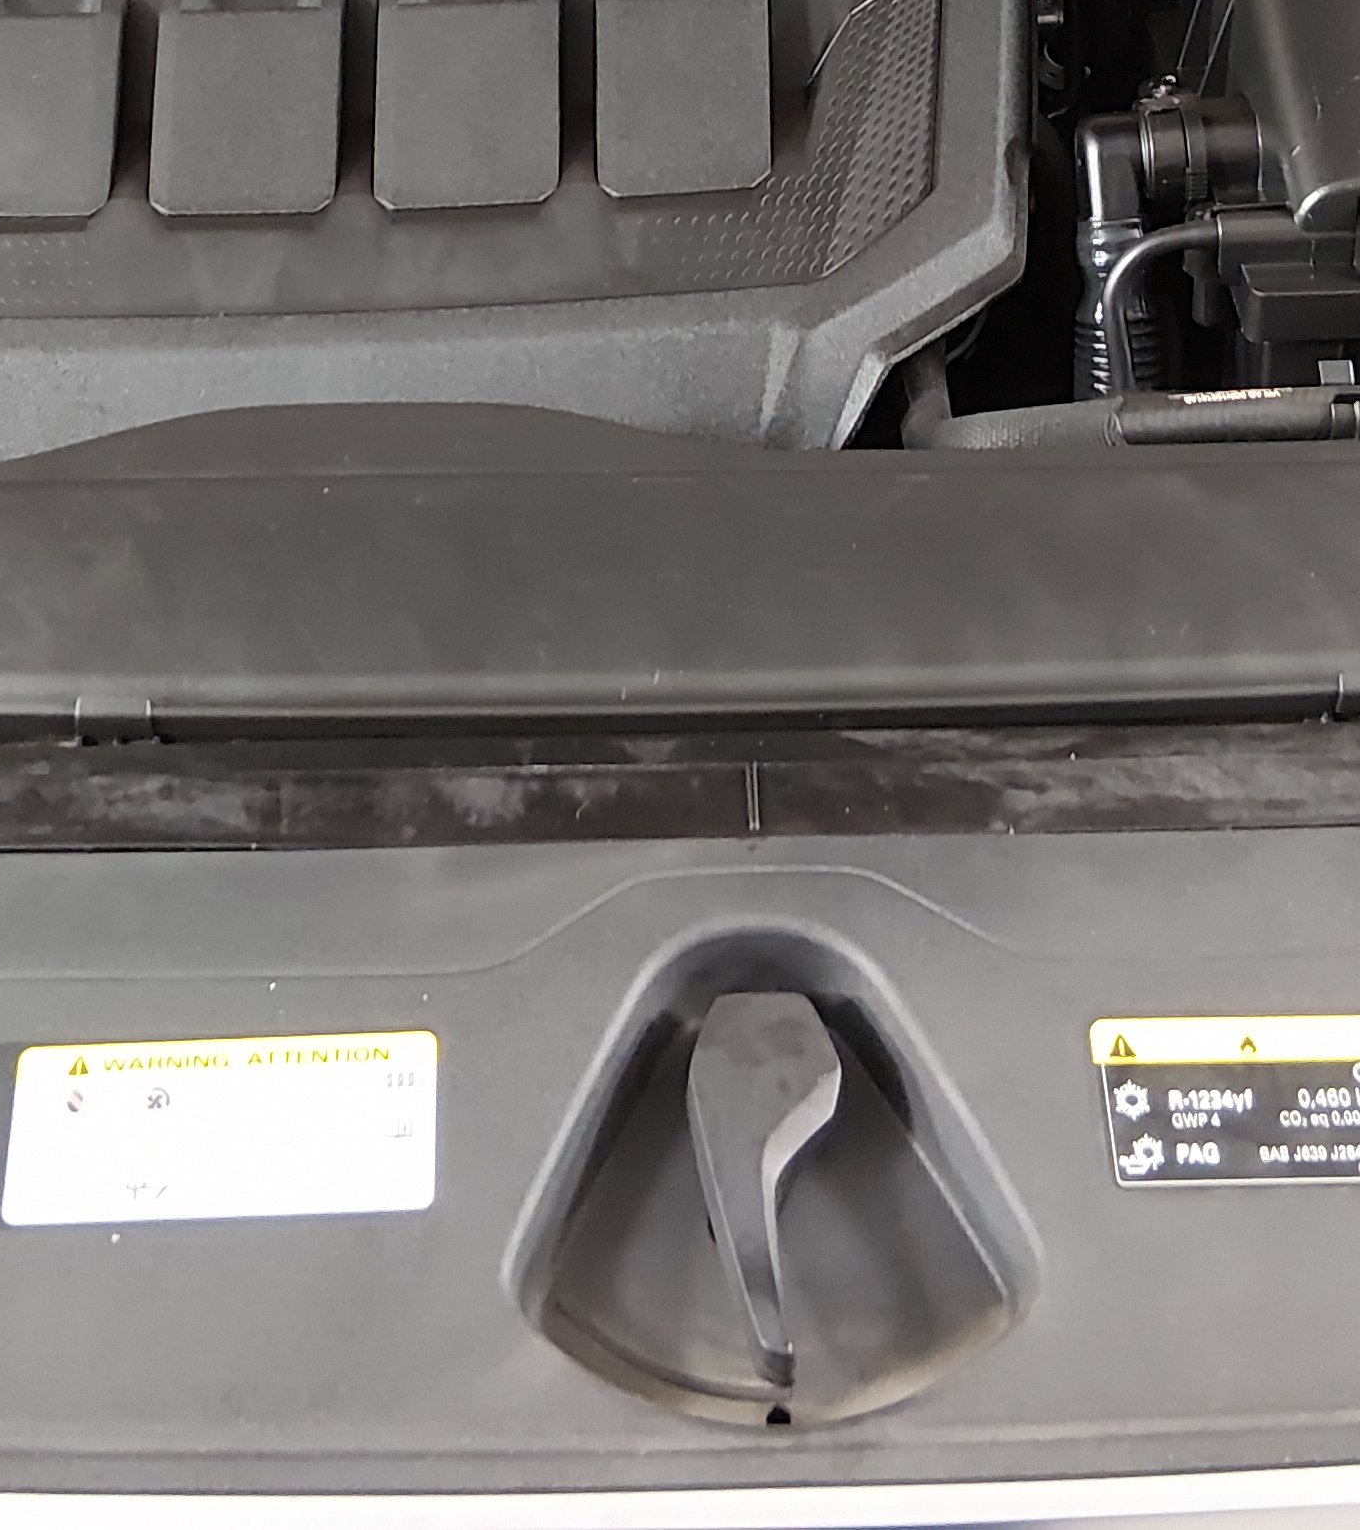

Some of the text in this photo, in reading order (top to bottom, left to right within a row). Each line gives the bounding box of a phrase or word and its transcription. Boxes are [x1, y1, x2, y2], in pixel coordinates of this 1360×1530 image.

[103, 1047, 391, 1071] WARNING ATTENTION
[1168, 1089, 1254, 1113] R-1234yf
[1176, 1142, 1221, 1165] PAG
